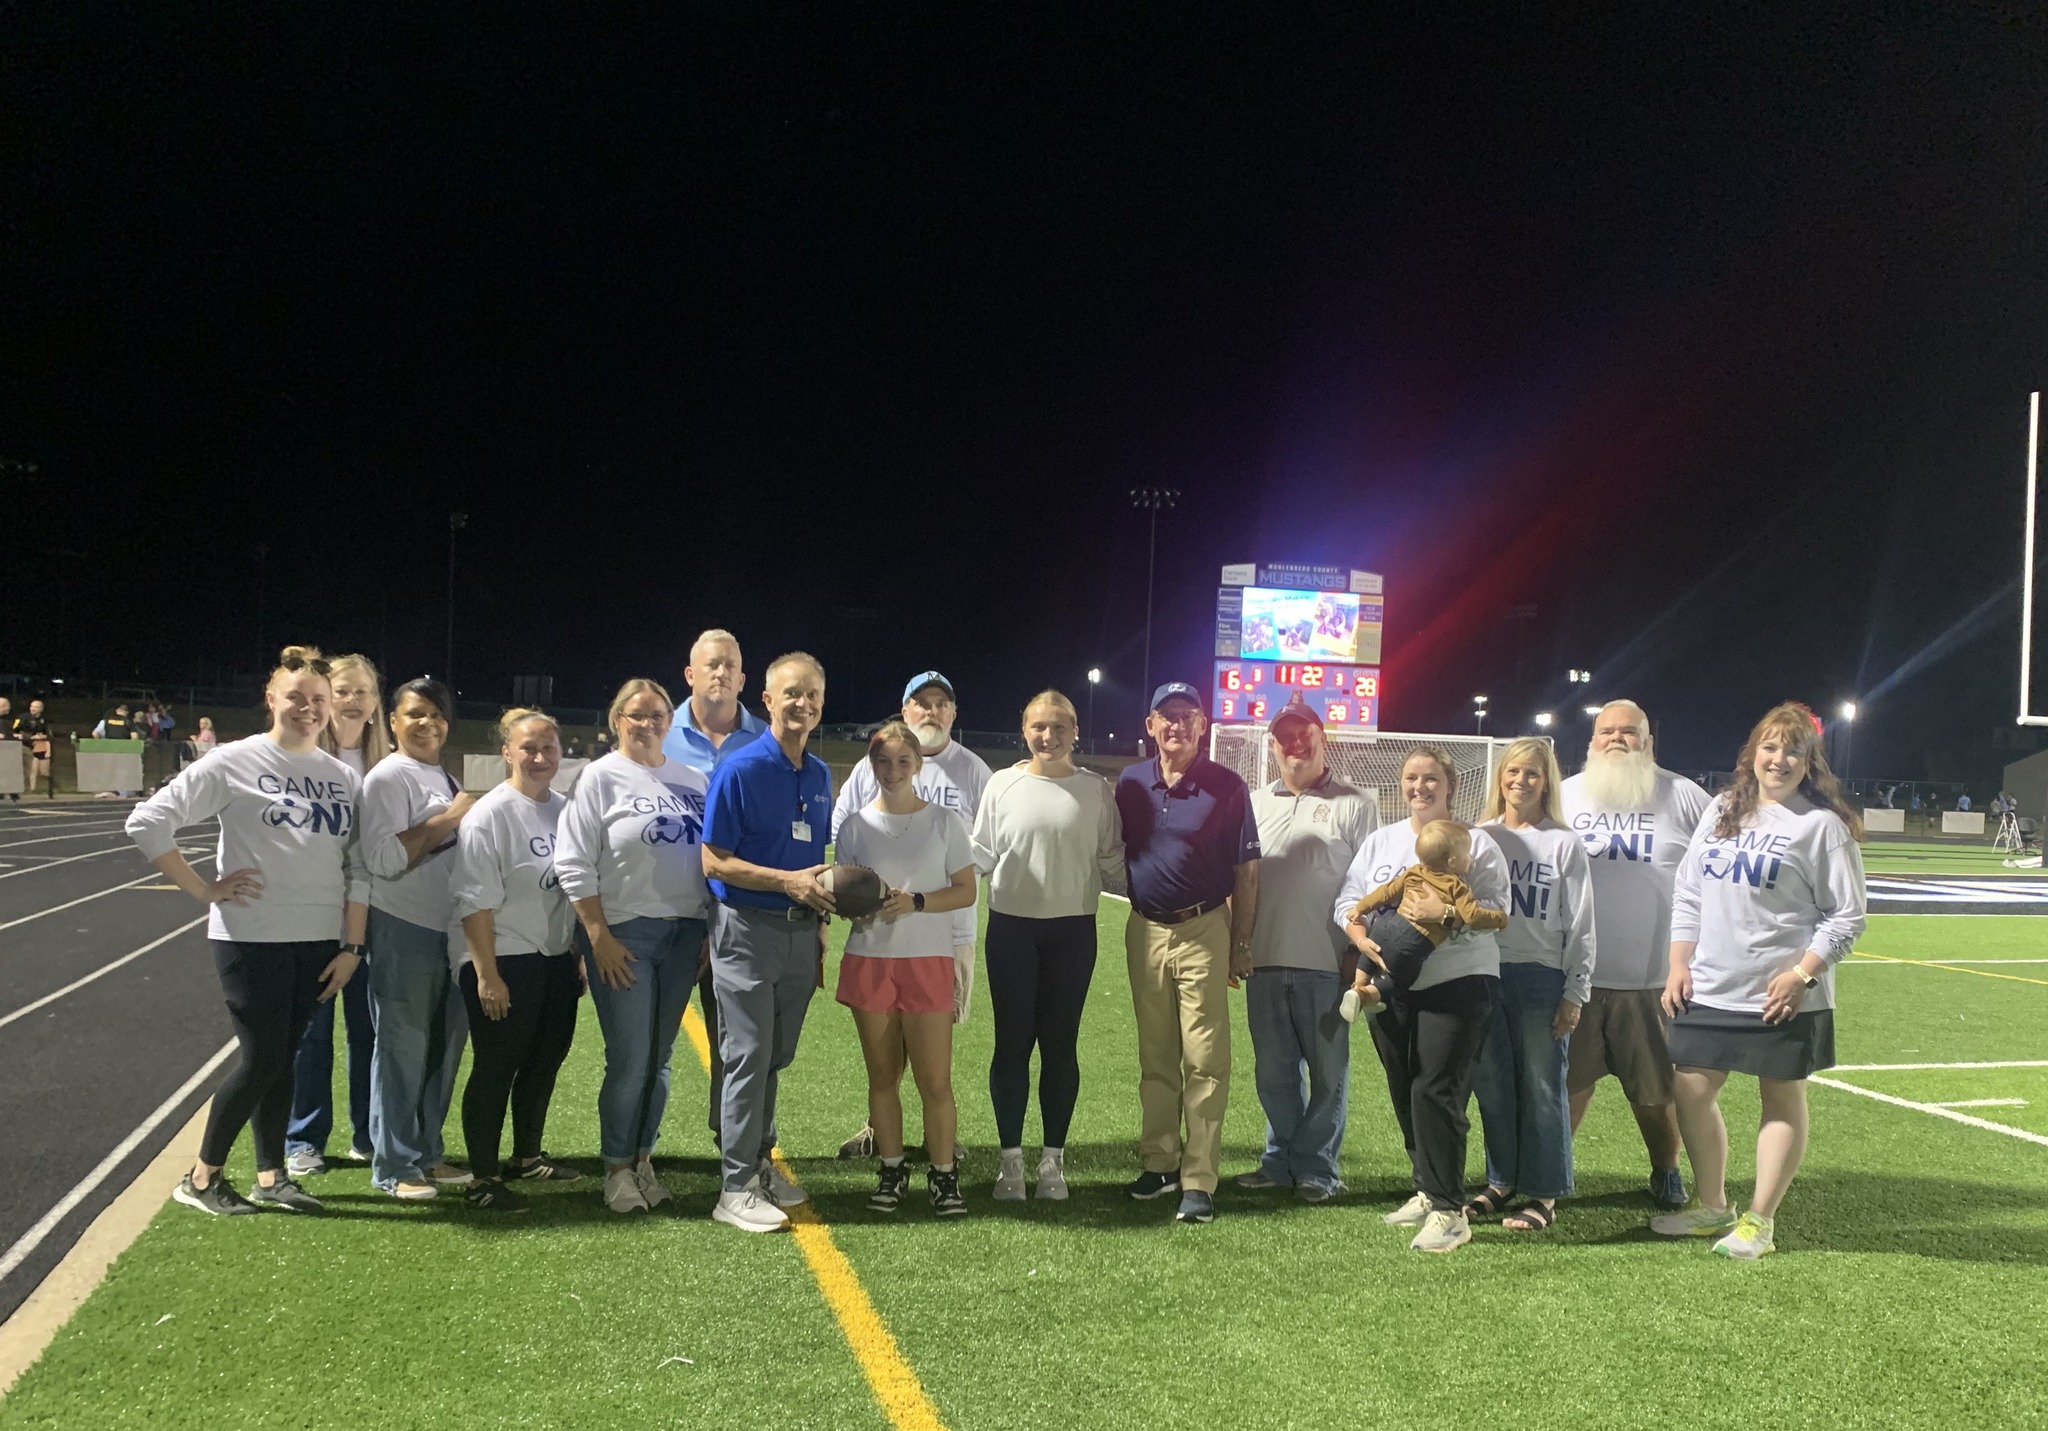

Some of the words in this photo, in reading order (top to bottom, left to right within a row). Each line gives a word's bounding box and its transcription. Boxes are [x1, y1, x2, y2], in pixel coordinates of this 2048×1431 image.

[1259, 571, 1346, 588] MUSTANGS
[1217, 663, 1241, 672] HOME
[1353, 668, 1379, 678] GUEST
[1228, 670, 1241, 691] 6
[1355, 677, 1376, 697] 28
[1217, 692, 1240, 700] DOWN
[1224, 699, 1233, 716] 3
[1254, 701, 1265, 717] 2
[1329, 704, 1347, 721] 28
[1360, 706, 1370, 722] 3
[258, 774, 350, 803] GAME
[633, 794, 705, 814] GAME
[1573, 812, 1655, 832] GAME
